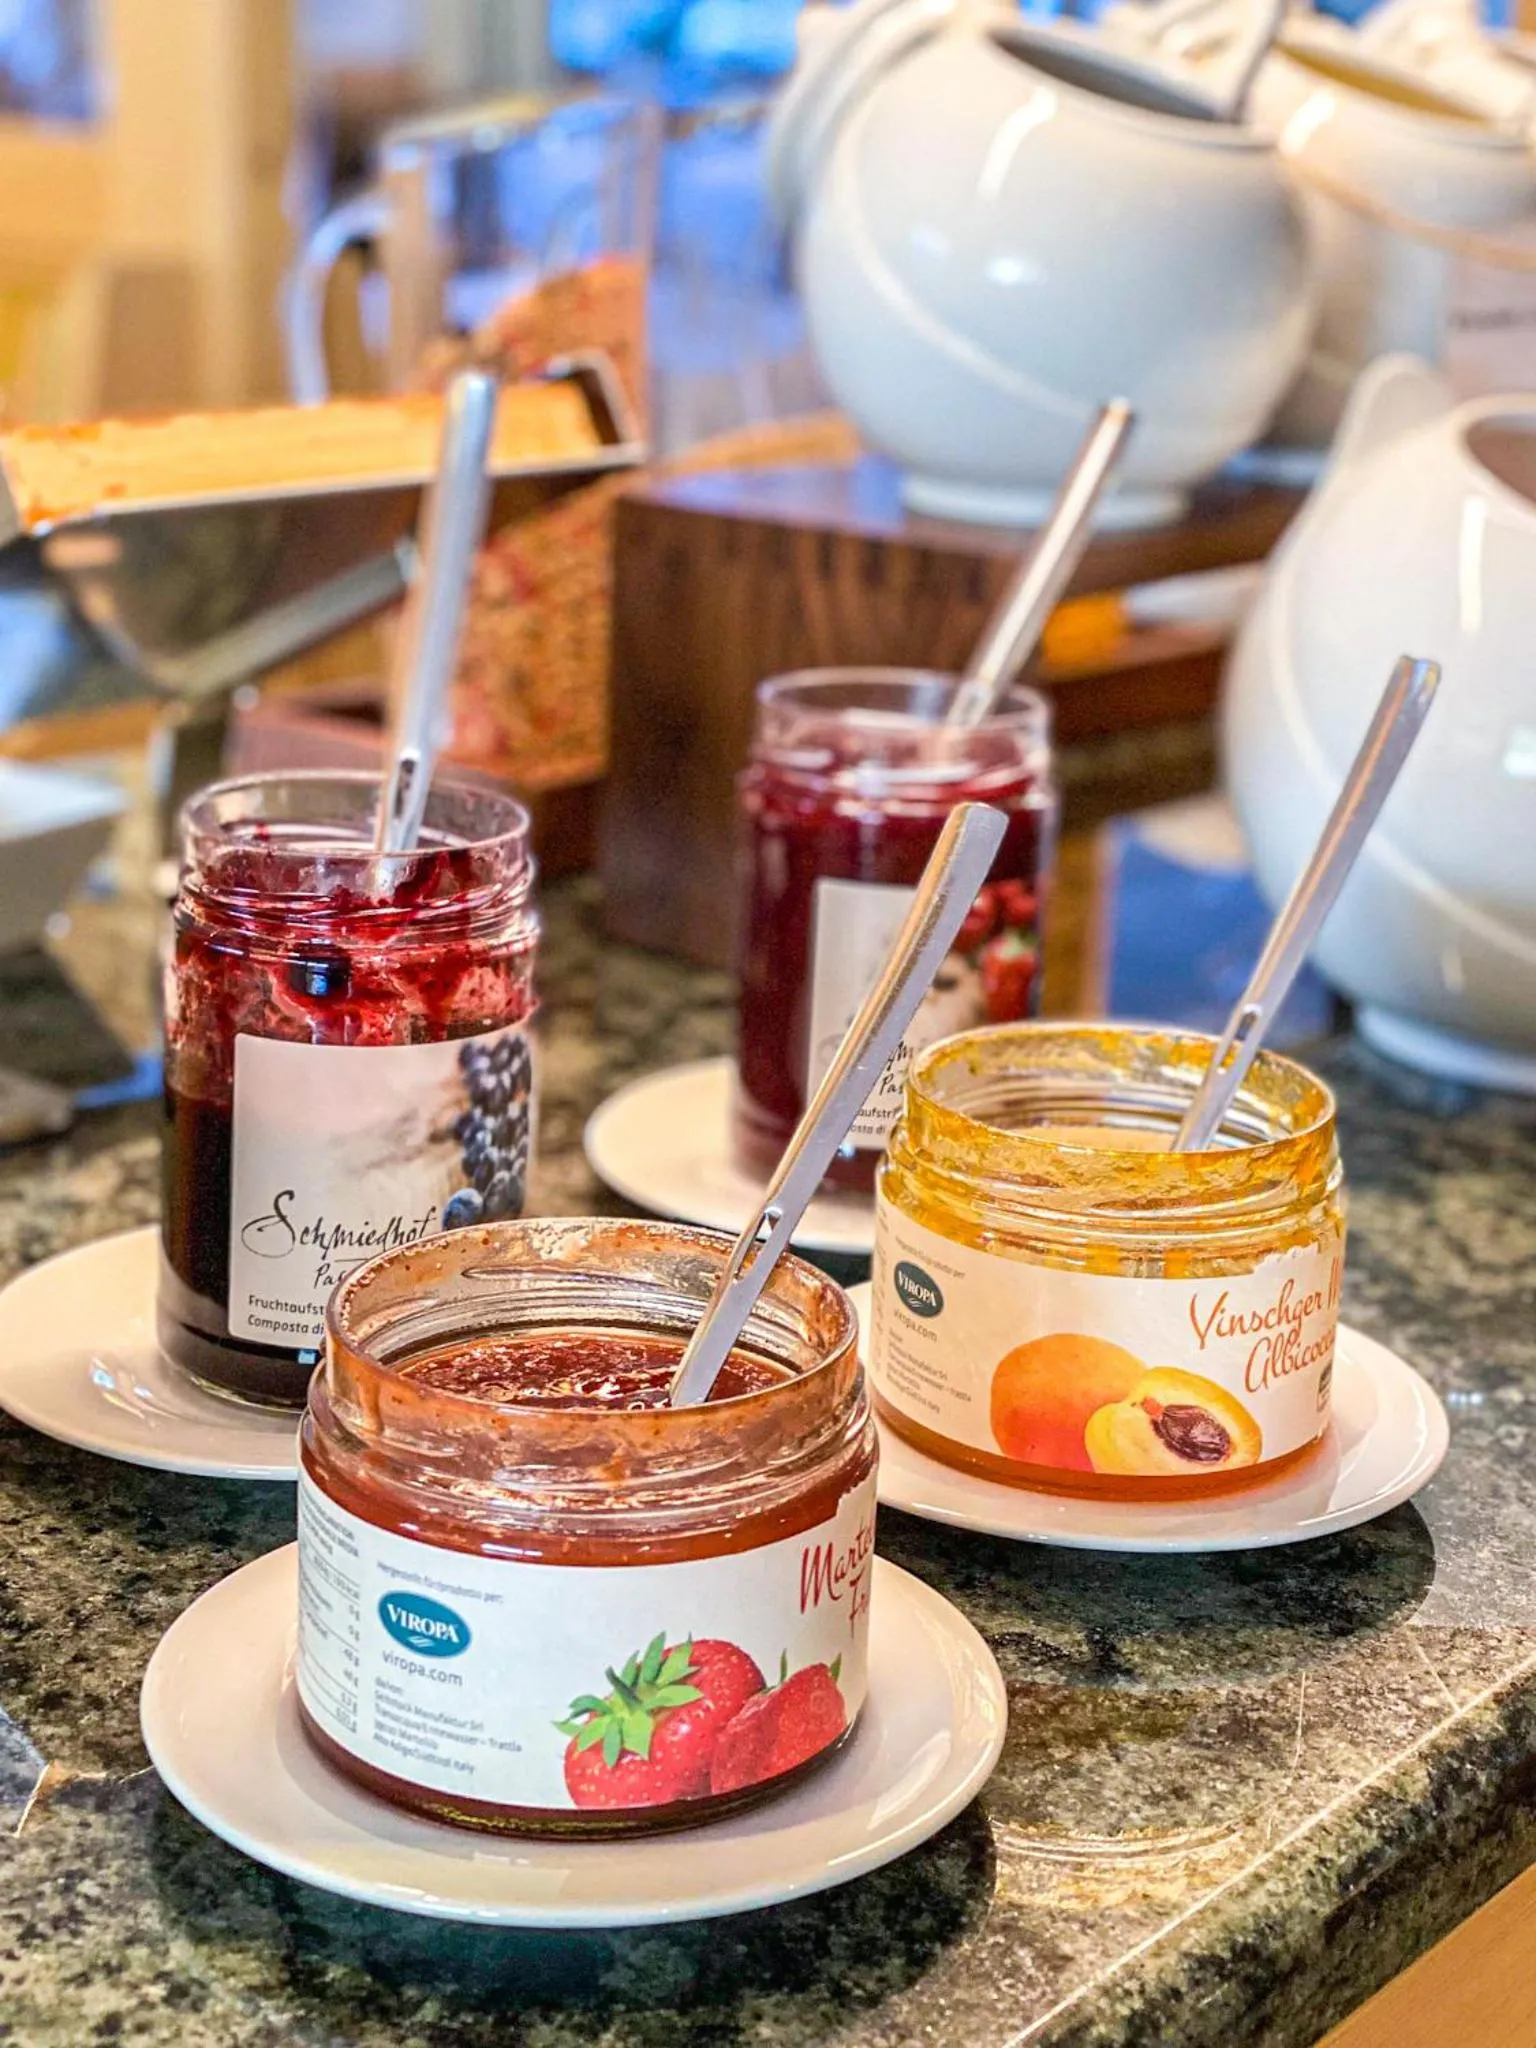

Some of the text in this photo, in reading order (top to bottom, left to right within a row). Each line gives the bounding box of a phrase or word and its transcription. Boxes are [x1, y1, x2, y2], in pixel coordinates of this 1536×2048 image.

[241, 1190, 438, 1260] Schmiedhof
[248, 1294, 325, 1316] Fruchtaufst
[898, 1268, 938, 1308] VIROPA
[247, 1314, 325, 1335] Composta di
[1189, 1278, 1323, 1350] Vinschger
[386, 1603, 460, 1644] VIROPA
[382, 1650, 463, 1687] viropa.com
